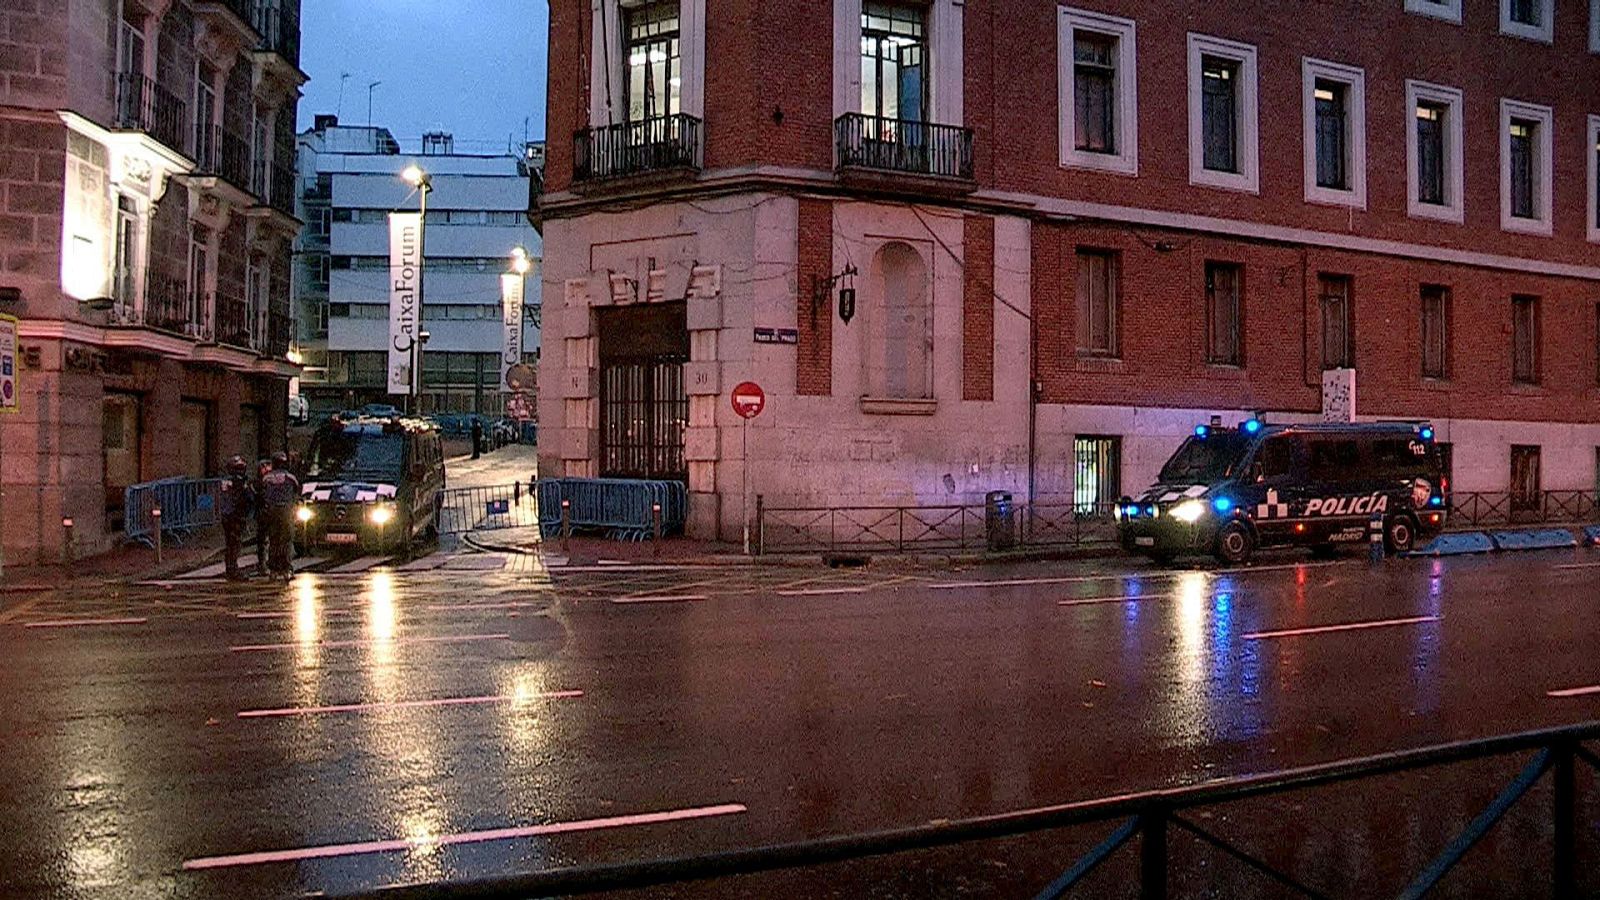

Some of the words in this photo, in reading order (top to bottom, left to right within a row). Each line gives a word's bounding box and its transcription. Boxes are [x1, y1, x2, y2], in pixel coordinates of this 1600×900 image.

[393, 226, 415, 352] CaixaForum
[505, 282, 519, 366] CaixaForum
[1303, 490, 1388, 516] POLICÍA
